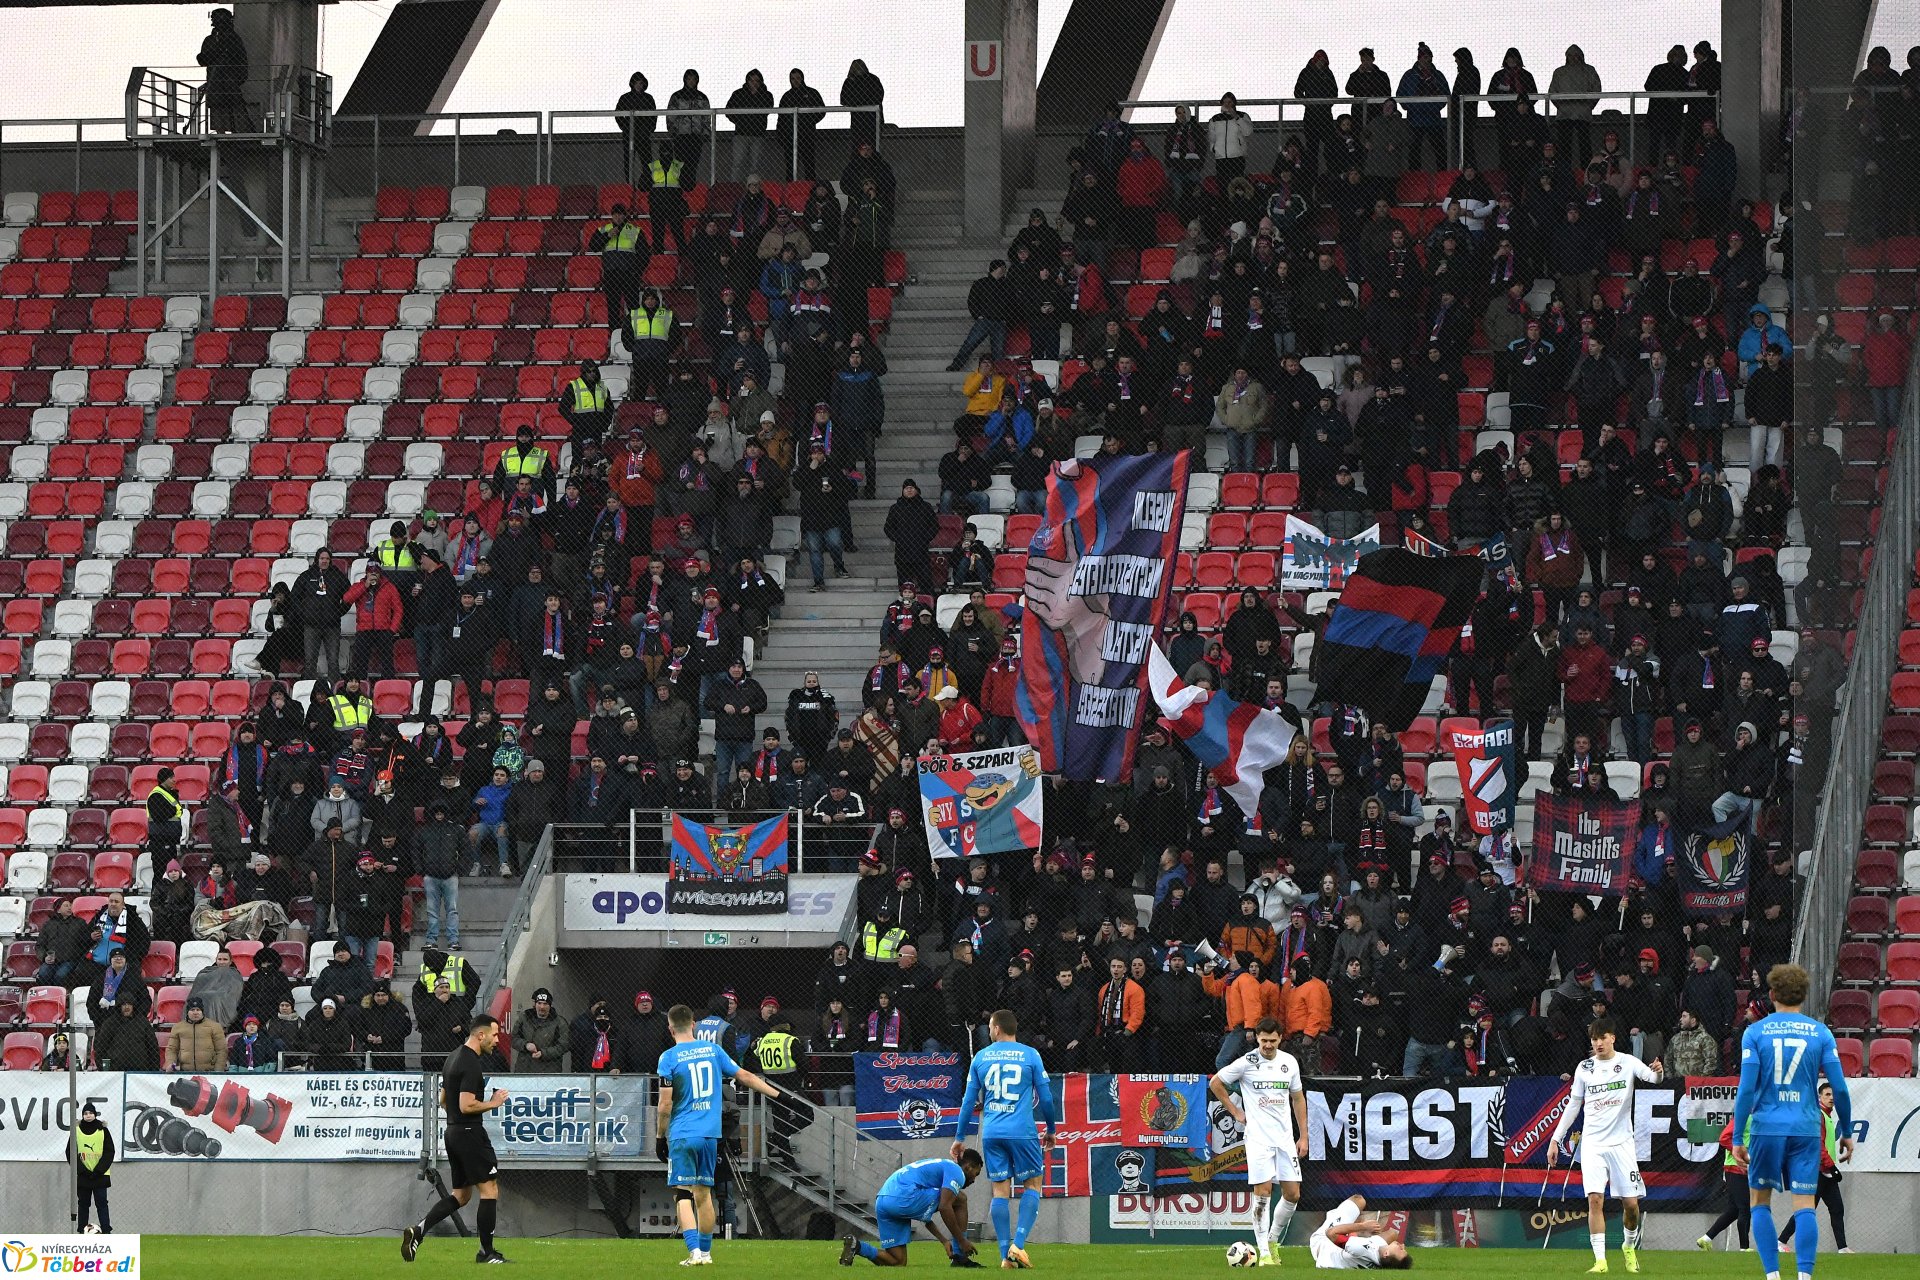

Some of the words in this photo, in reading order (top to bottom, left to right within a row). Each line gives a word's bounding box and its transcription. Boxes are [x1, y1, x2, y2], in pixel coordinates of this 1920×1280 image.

[971, 44, 996, 77] U
[1452, 728, 1513, 748] SZPARI
[920, 756, 949, 775] SÖR
[952, 758, 964, 772] &
[967, 752, 1015, 771] SZPARI
[1578, 811, 1601, 836] the
[1554, 830, 1620, 860] Mastiffs
[1558, 856, 1612, 889] Family
[1763, 1021, 1817, 1032] KOLORCITY
[760, 1046, 783, 1068] 106
[873, 1051, 959, 1070] Special
[1773, 1037, 1808, 1085] 17
[306, 1076, 341, 1091] KÁBEL
[345, 1076, 359, 1091] ÉS
[688, 1060, 714, 1099] 10
[881, 1074, 953, 1094] Guests
[984, 1063, 1022, 1101] 42
[373, 1093, 387, 1108] ÉS
[491, 1088, 581, 1118] hauff
[294, 1125, 310, 1138] Mi
[314, 1125, 351, 1138] ésszel
[355, 1126, 410, 1141] megyünk
[1348, 1101, 1359, 1154] 1995
[345, 1147, 416, 1157] www.hauff-technik.hu
